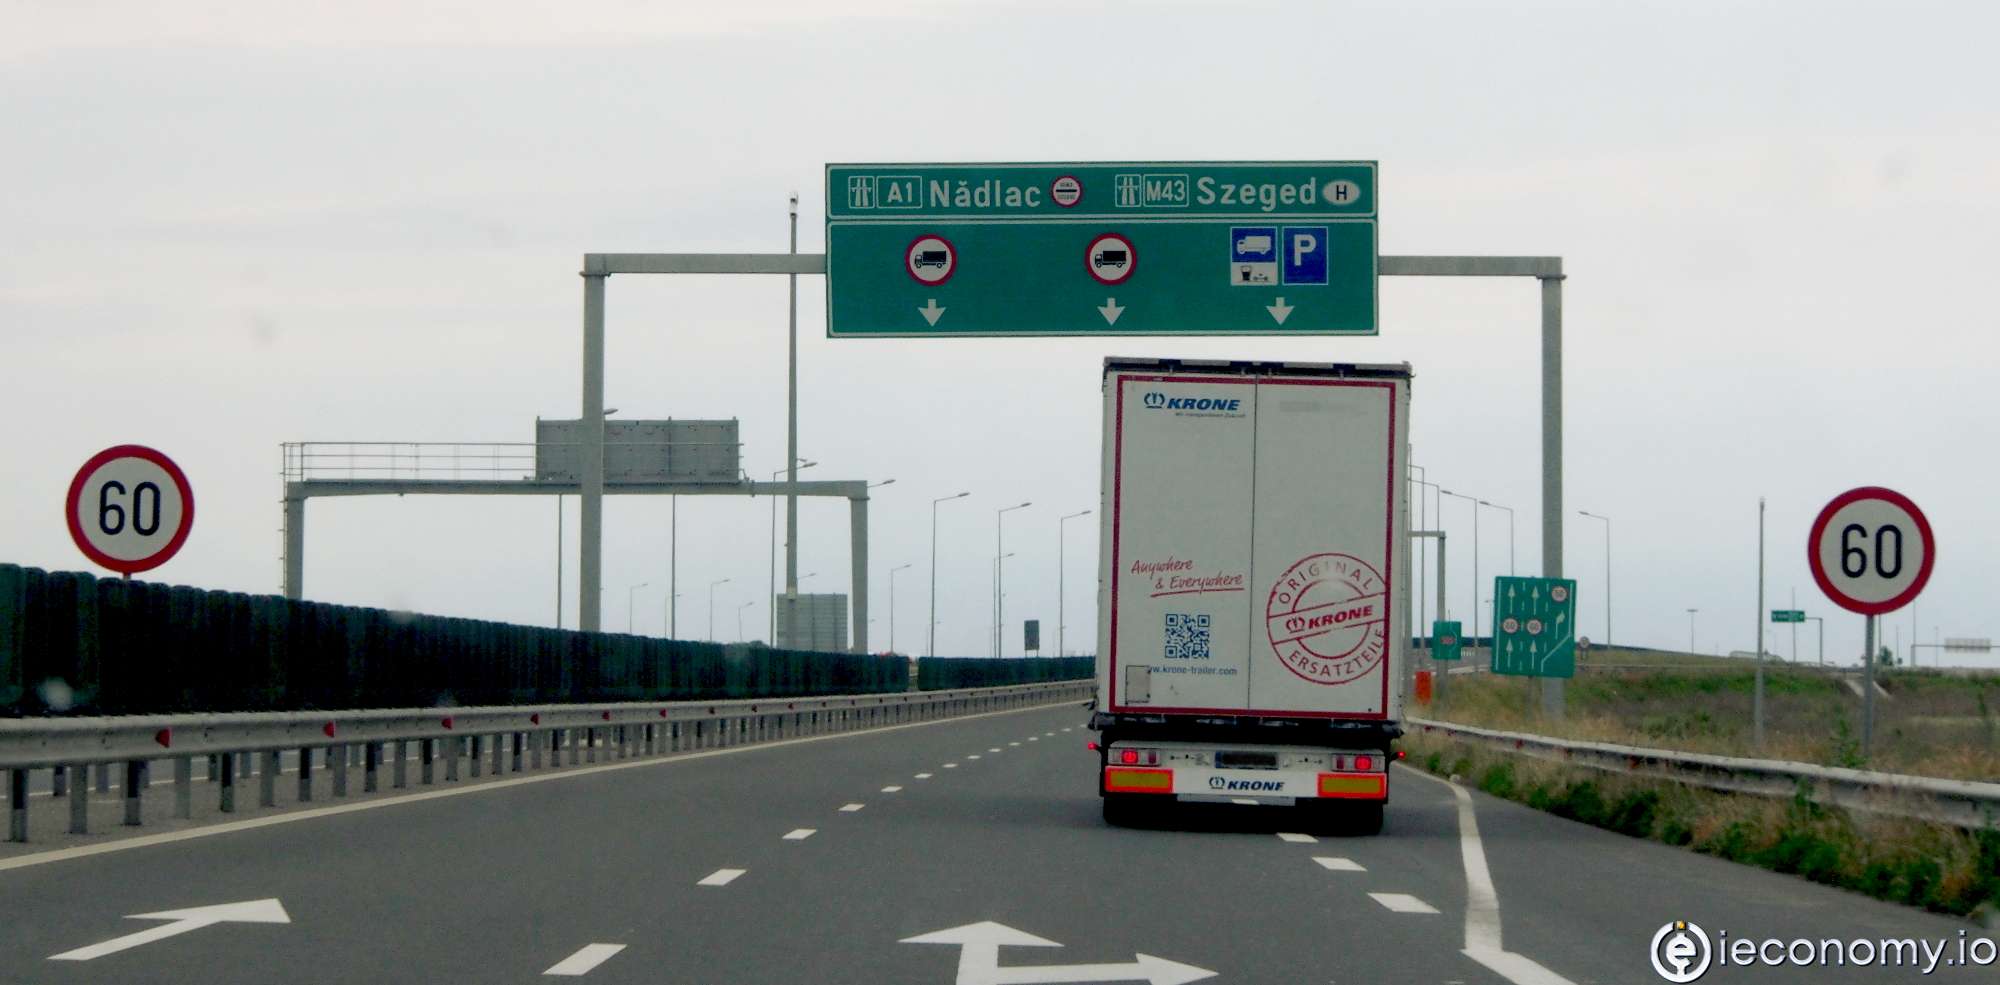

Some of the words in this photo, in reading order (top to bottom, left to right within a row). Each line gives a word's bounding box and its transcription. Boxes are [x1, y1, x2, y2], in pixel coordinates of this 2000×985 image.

[887, 182, 913, 203] A1
[930, 179, 1041, 208] Nădlac
[1146, 180, 1186, 202] M43
[1196, 176, 1317, 212] Szeged
[1335, 184, 1348, 201] H
[1293, 234, 1317, 266] P
[1167, 397, 1240, 411] KRONE
[99, 480, 161, 536] 60
[1841, 523, 1901, 579] 60
[1131, 556, 1193, 580] Anywhere
[1155, 578, 1164, 590] &
[1170, 571, 1242, 594] Everywhere
[1278, 560, 1373, 604] ORIGINAL
[1308, 605, 1373, 630] KRONE
[1289, 628, 1384, 677] ERSATZTEILE
[1228, 781, 1285, 791] KRONE
